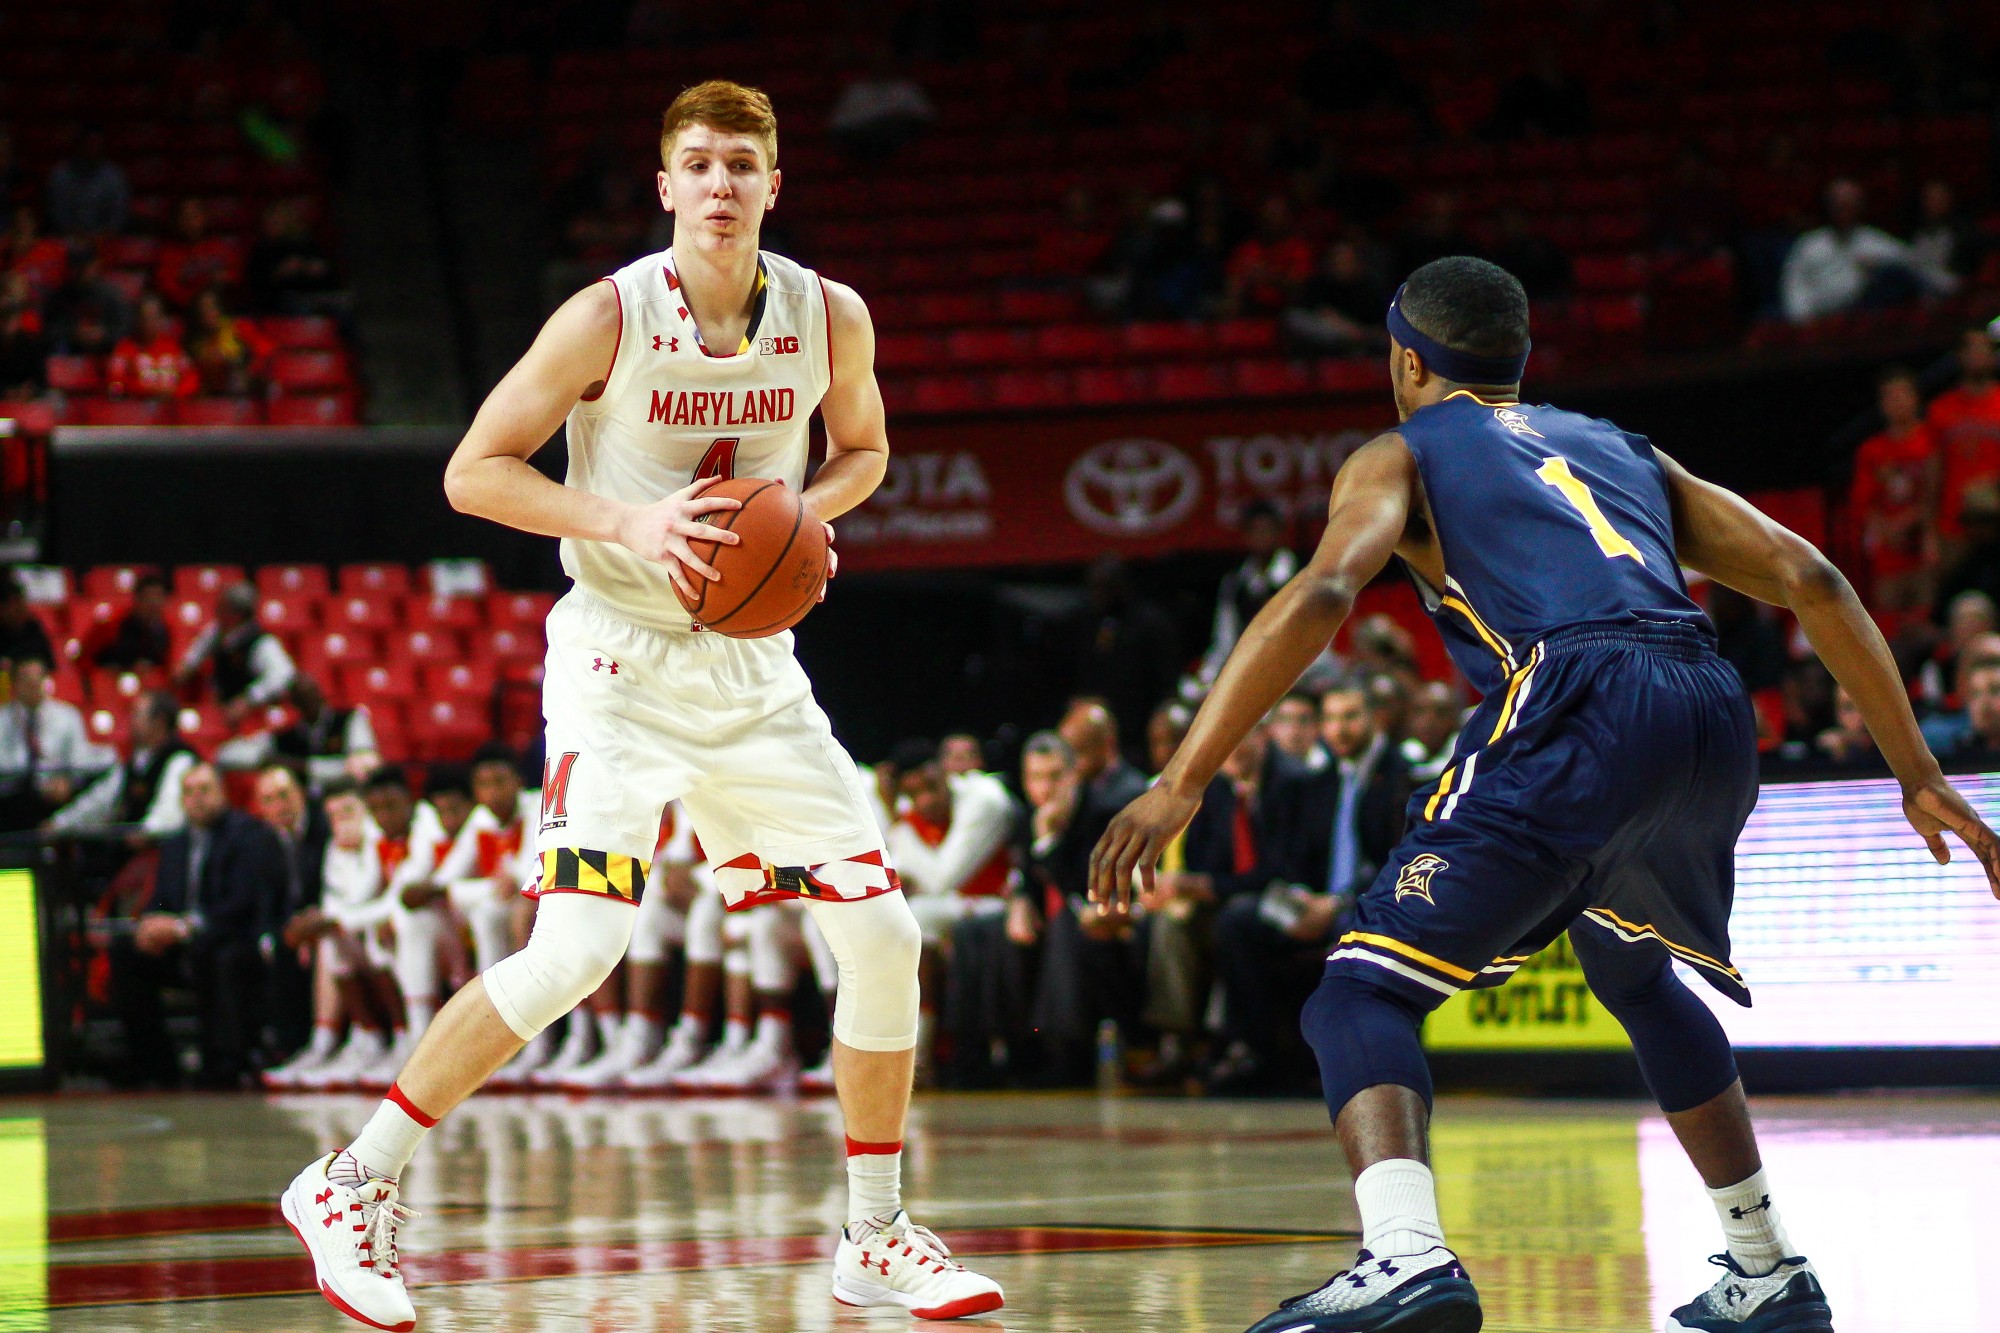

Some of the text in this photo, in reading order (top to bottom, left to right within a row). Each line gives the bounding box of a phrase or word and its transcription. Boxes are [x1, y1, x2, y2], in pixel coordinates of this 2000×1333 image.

[647, 388, 794, 426] MARYLAND
[1534, 456, 1646, 567] 1
[540, 751, 580, 826] M
